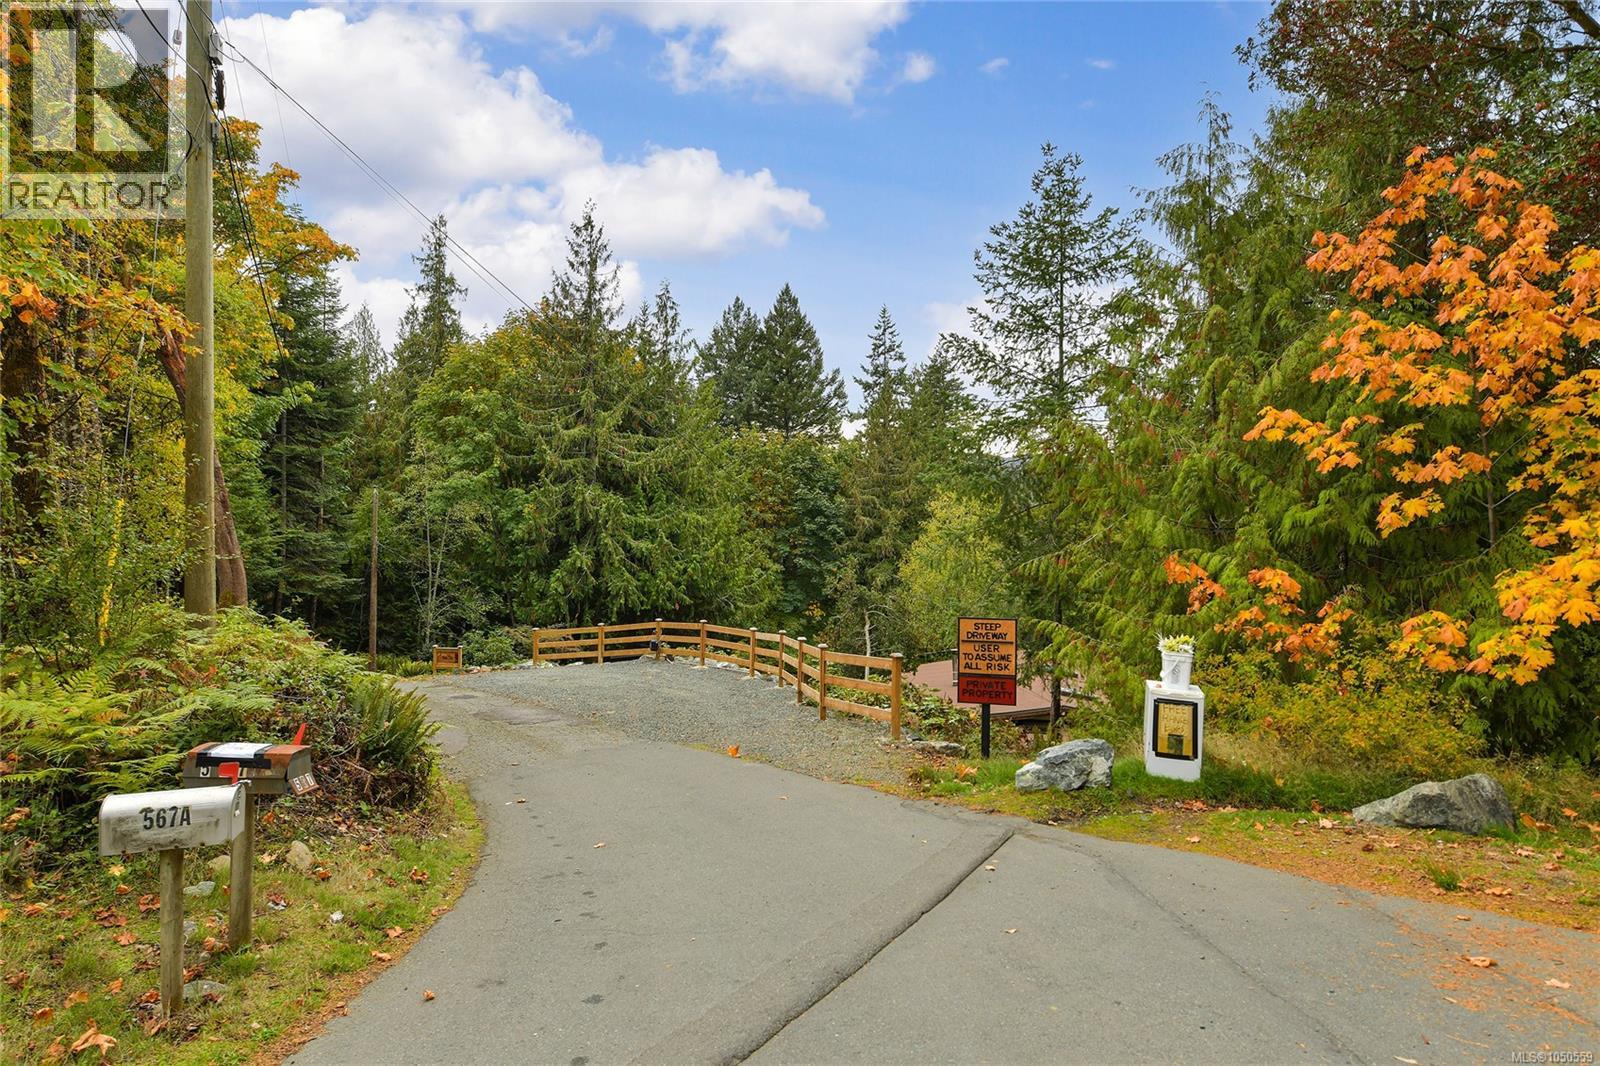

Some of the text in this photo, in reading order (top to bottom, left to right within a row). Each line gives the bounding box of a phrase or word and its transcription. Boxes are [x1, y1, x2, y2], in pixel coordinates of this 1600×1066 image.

[974, 622, 1002, 631] STEEP
[966, 631, 1008, 640] DRIVEWAY
[973, 644, 1000, 653] USER
[963, 652, 1012, 662] TO ASSUME
[964, 662, 1010, 671] ALL RISK
[966, 680, 1007, 690] PRIVATE
[962, 688, 1013, 699] PROPERTY
[142, 805, 192, 830] 567A
